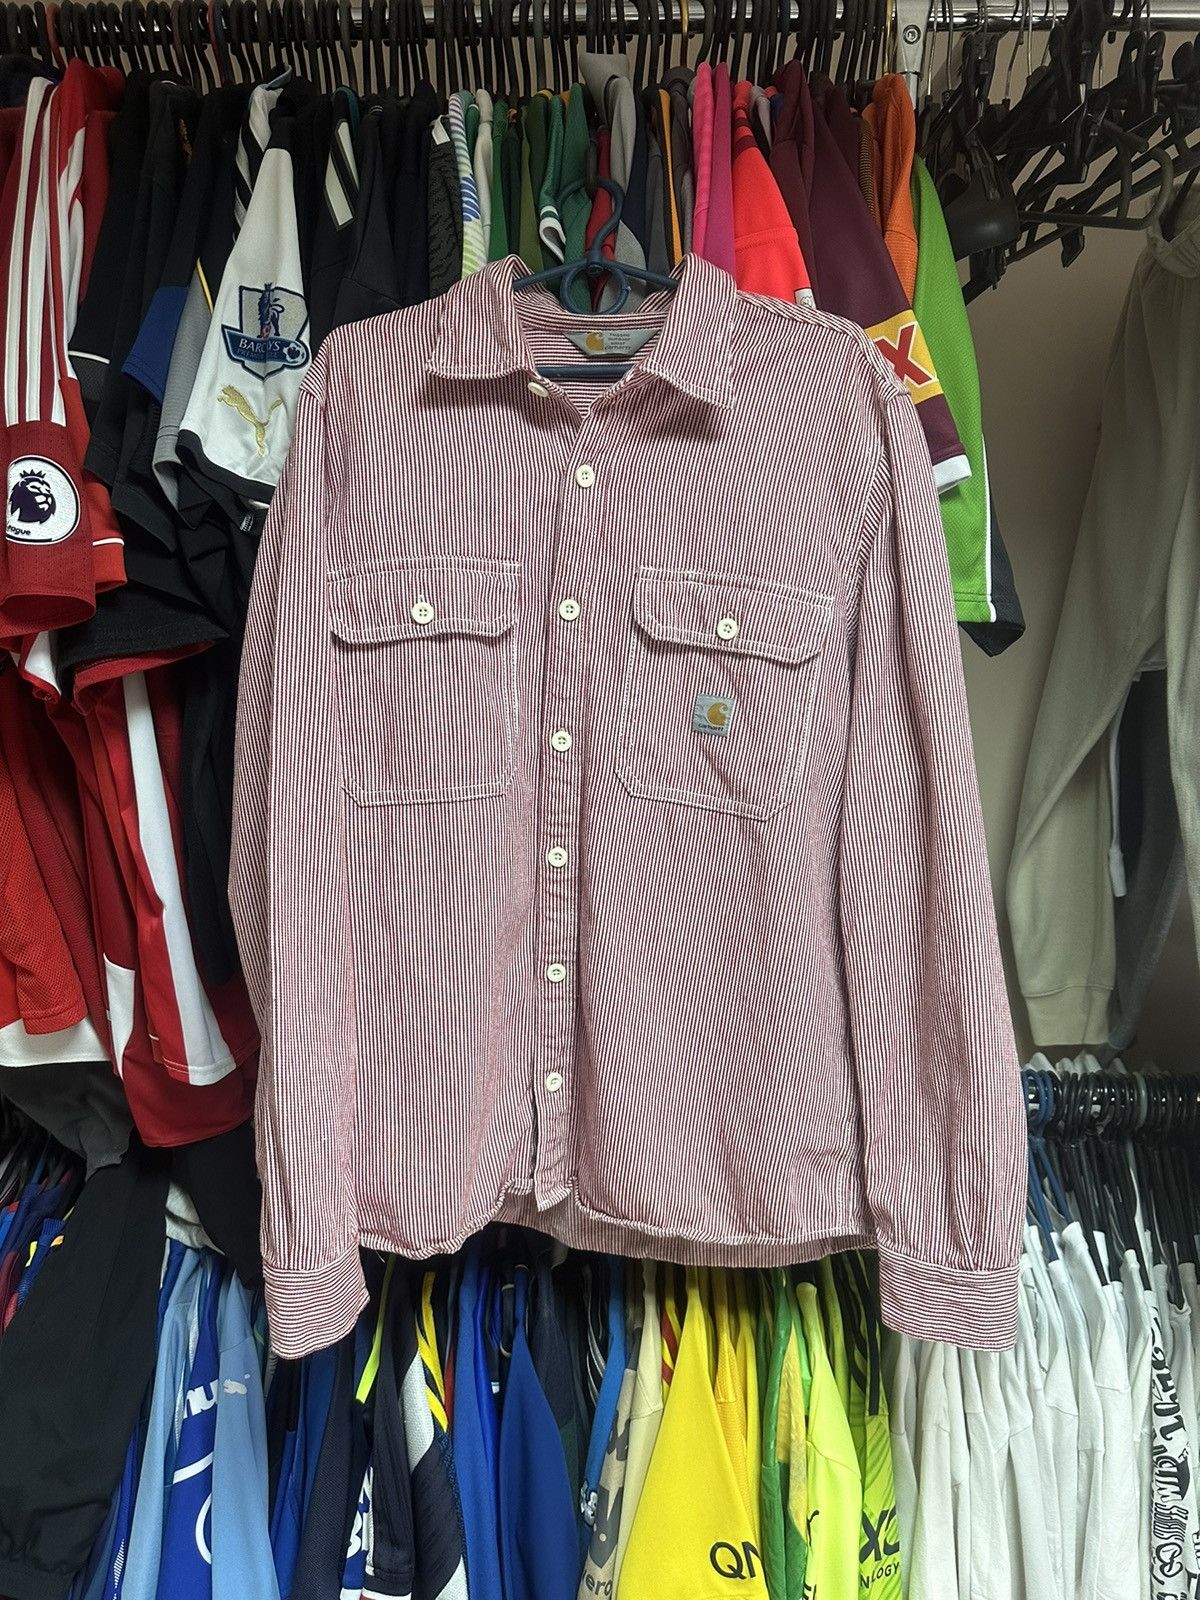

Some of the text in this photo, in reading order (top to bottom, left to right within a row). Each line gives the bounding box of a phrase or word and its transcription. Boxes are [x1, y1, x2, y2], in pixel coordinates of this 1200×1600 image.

[239, 338, 282, 353] BARCYS
[1153, 1502, 1189, 1542] STRIPES
[860, 1561, 900, 1589] NLOGY
